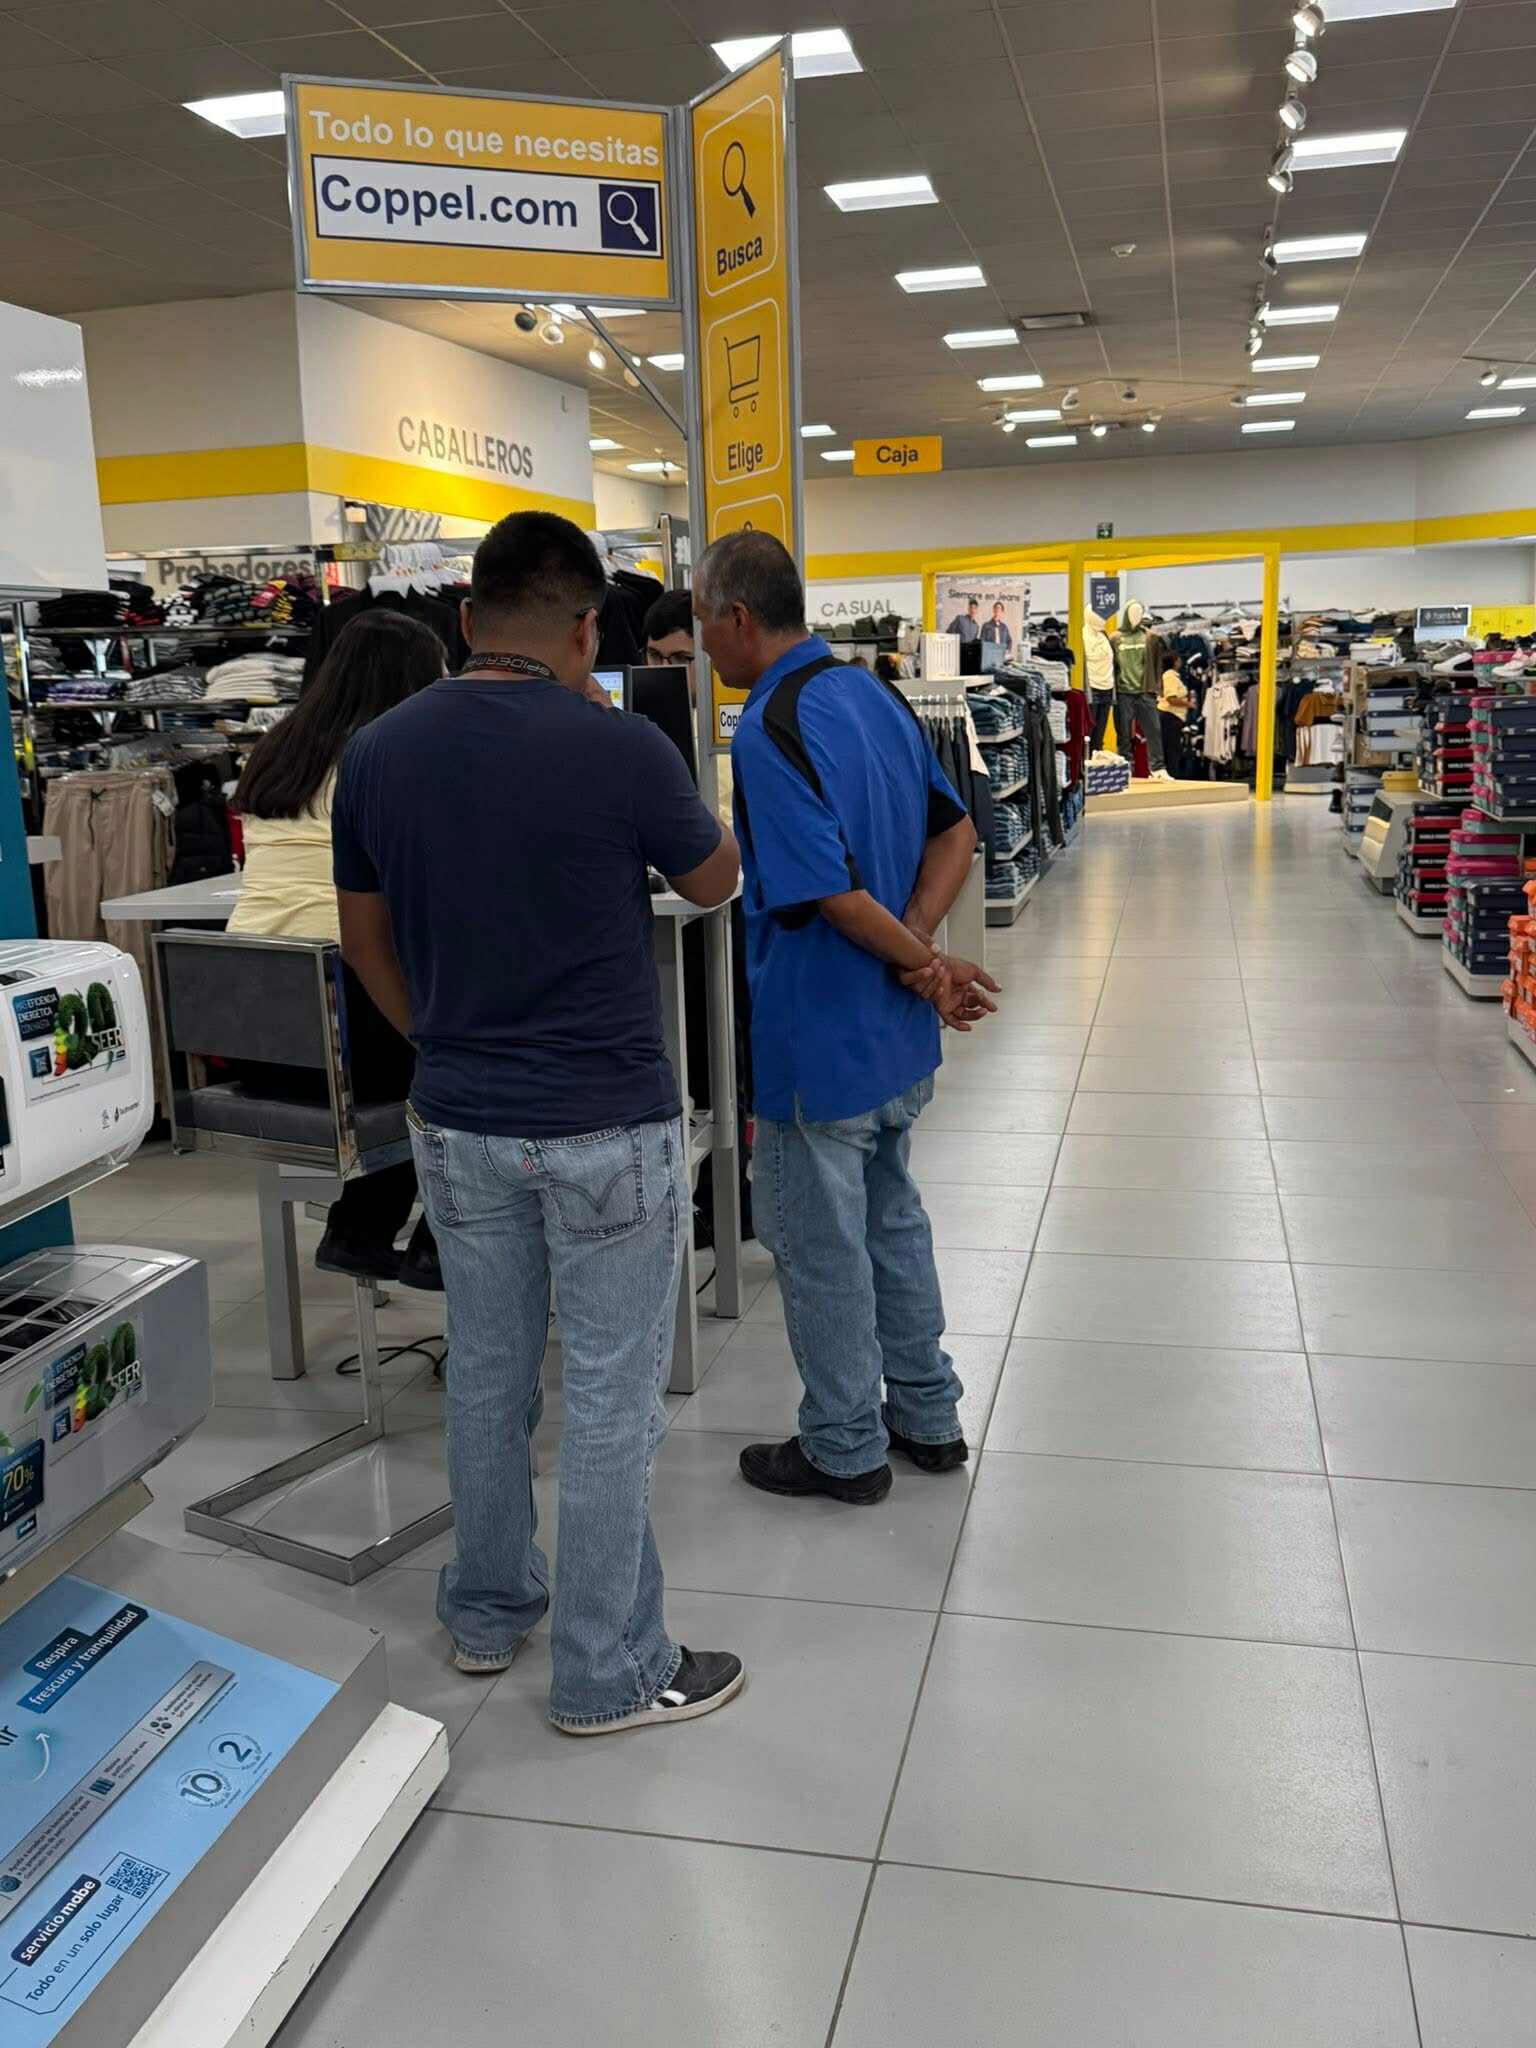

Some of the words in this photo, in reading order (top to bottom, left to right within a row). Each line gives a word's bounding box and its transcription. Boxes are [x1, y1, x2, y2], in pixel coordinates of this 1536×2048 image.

[308, 109, 394, 146] Todo
[403, 118, 434, 148] lo
[443, 129, 504, 158] que
[513, 133, 660, 167] necesitas
[320, 174, 578, 228] Coppel.com
[716, 236, 763, 277] Busca
[398, 416, 534, 479] CABALLEROS
[727, 442, 763, 472] Elige
[875, 445, 919, 467] Caja
[820, 599, 897, 618] CASUAL
[91, 1026, 123, 1053] SEER
[28, 1666, 75, 1706] frescura
[71, 1660, 85, 1672] y
[78, 1609, 139, 1662] tranquilidad
[34, 1636, 79, 1671] Respira
[218, 1741, 253, 1763] 2
[180, 1773, 223, 1803] 10
[25, 1974, 57, 2001] Todo
[54, 1959, 71, 1974] en
[67, 1943, 85, 1958] un
[80, 1921, 102, 1945] solo
[95, 1894, 125, 1921] lugar
